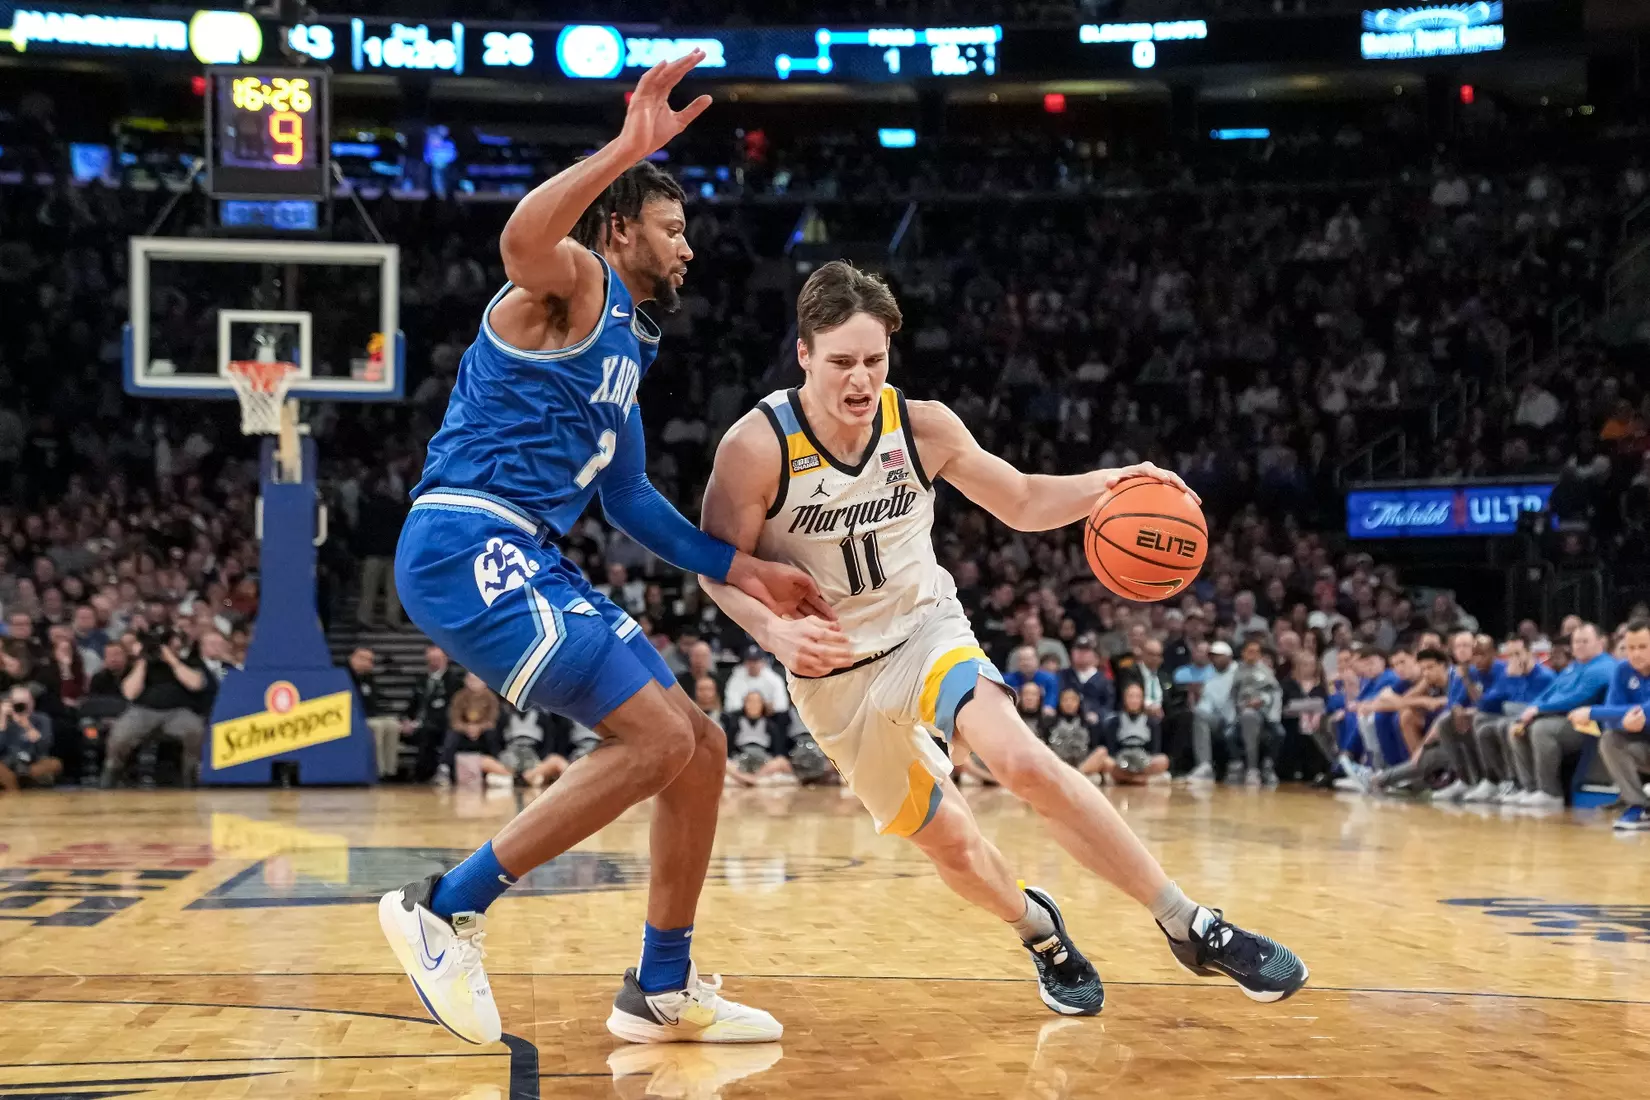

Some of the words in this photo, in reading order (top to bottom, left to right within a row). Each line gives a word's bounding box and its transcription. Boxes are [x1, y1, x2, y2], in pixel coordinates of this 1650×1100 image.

[268, 111, 303, 165] 9
[574, 428, 616, 490] 2
[788, 484, 917, 536] Marquette
[839, 530, 887, 596] 11
[1136, 529, 1197, 558] ELITE
[221, 704, 344, 761] Schweppes
